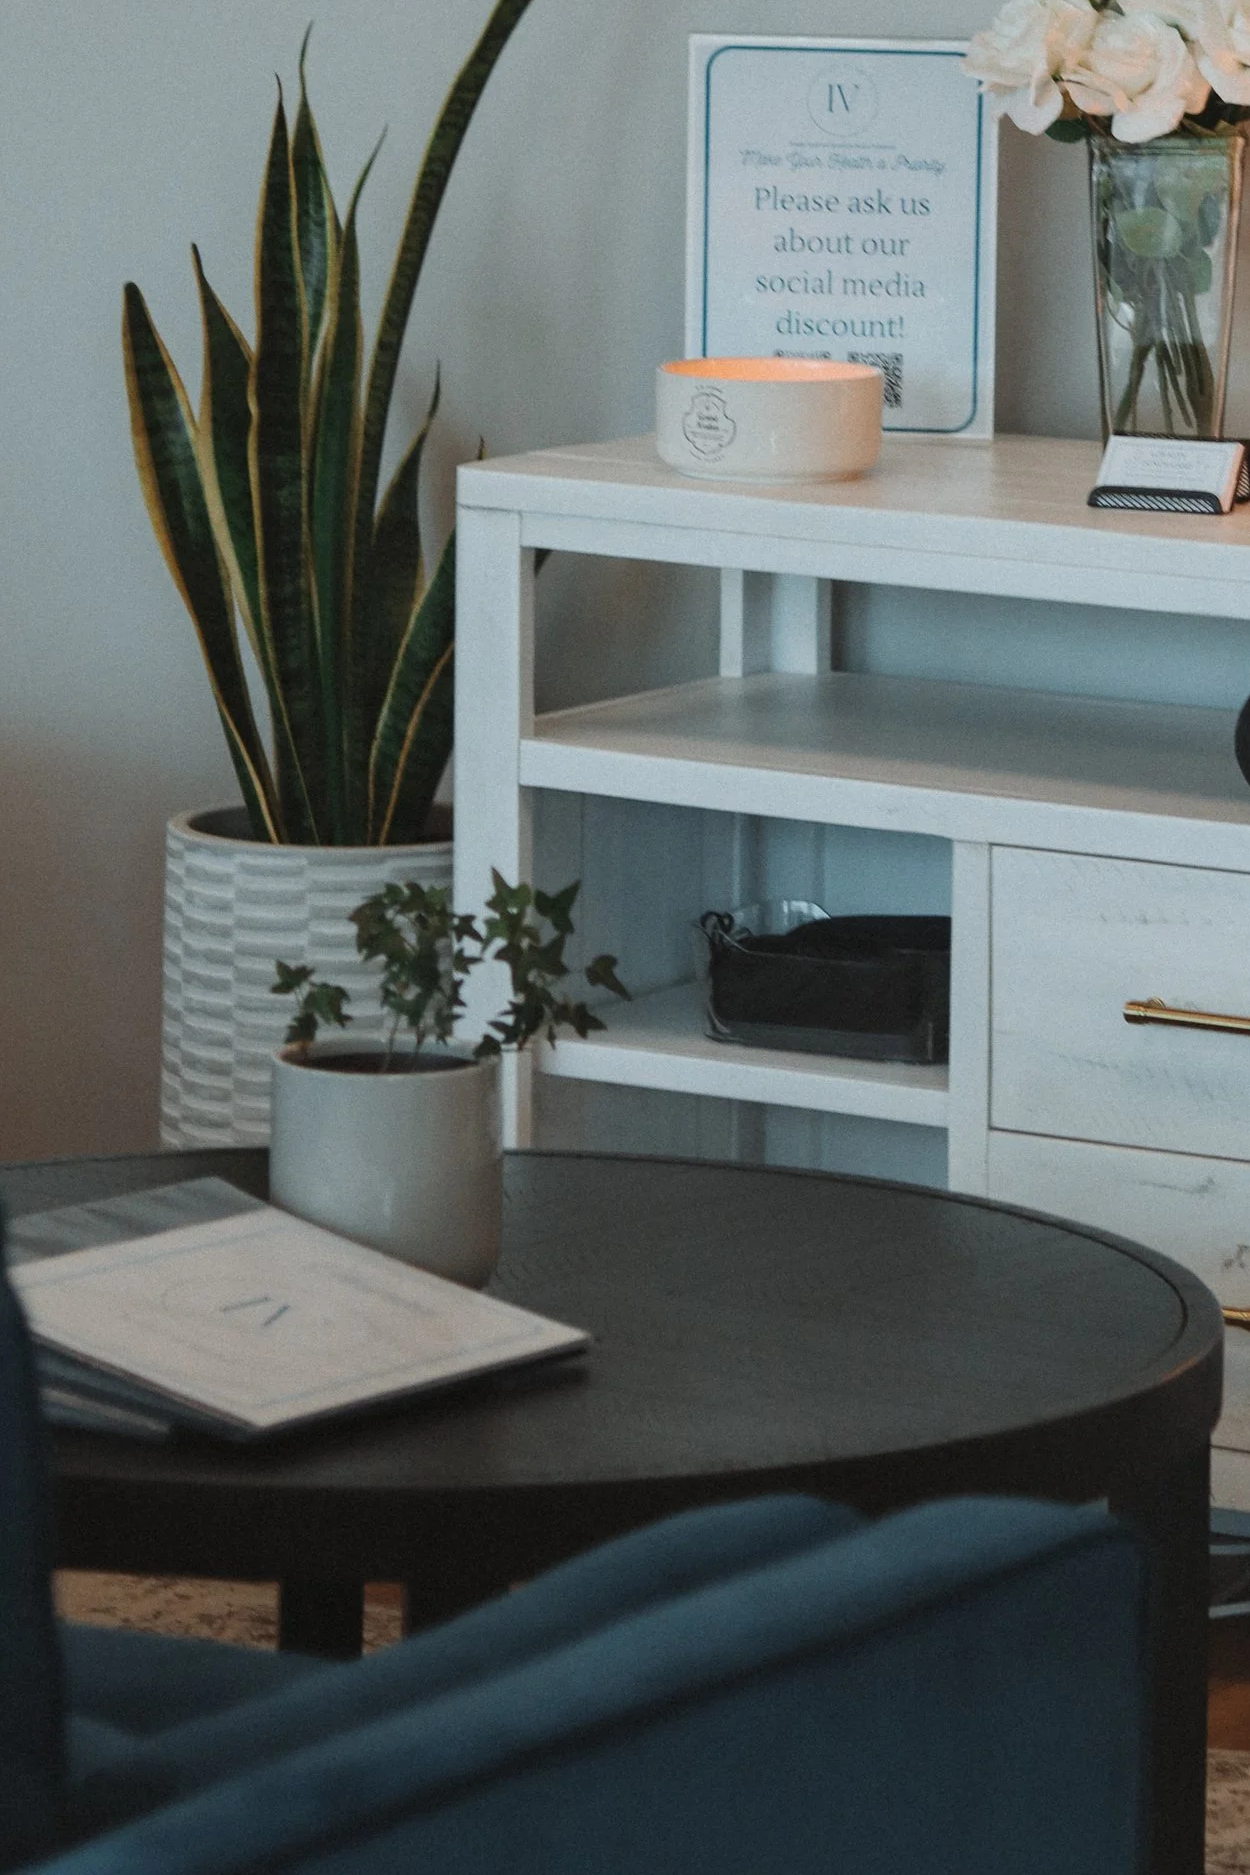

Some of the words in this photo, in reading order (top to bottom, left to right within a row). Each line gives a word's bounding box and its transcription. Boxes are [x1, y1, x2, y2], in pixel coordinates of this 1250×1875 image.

[754, 185, 840, 213] Please
[847, 188, 893, 215] ask
[901, 196, 931, 217] us
[773, 227, 853, 255] about
[861, 236, 911, 257] our
[755, 269, 834, 296] social
[842, 271, 926, 299] media
[775, 309, 905, 339] discount!
